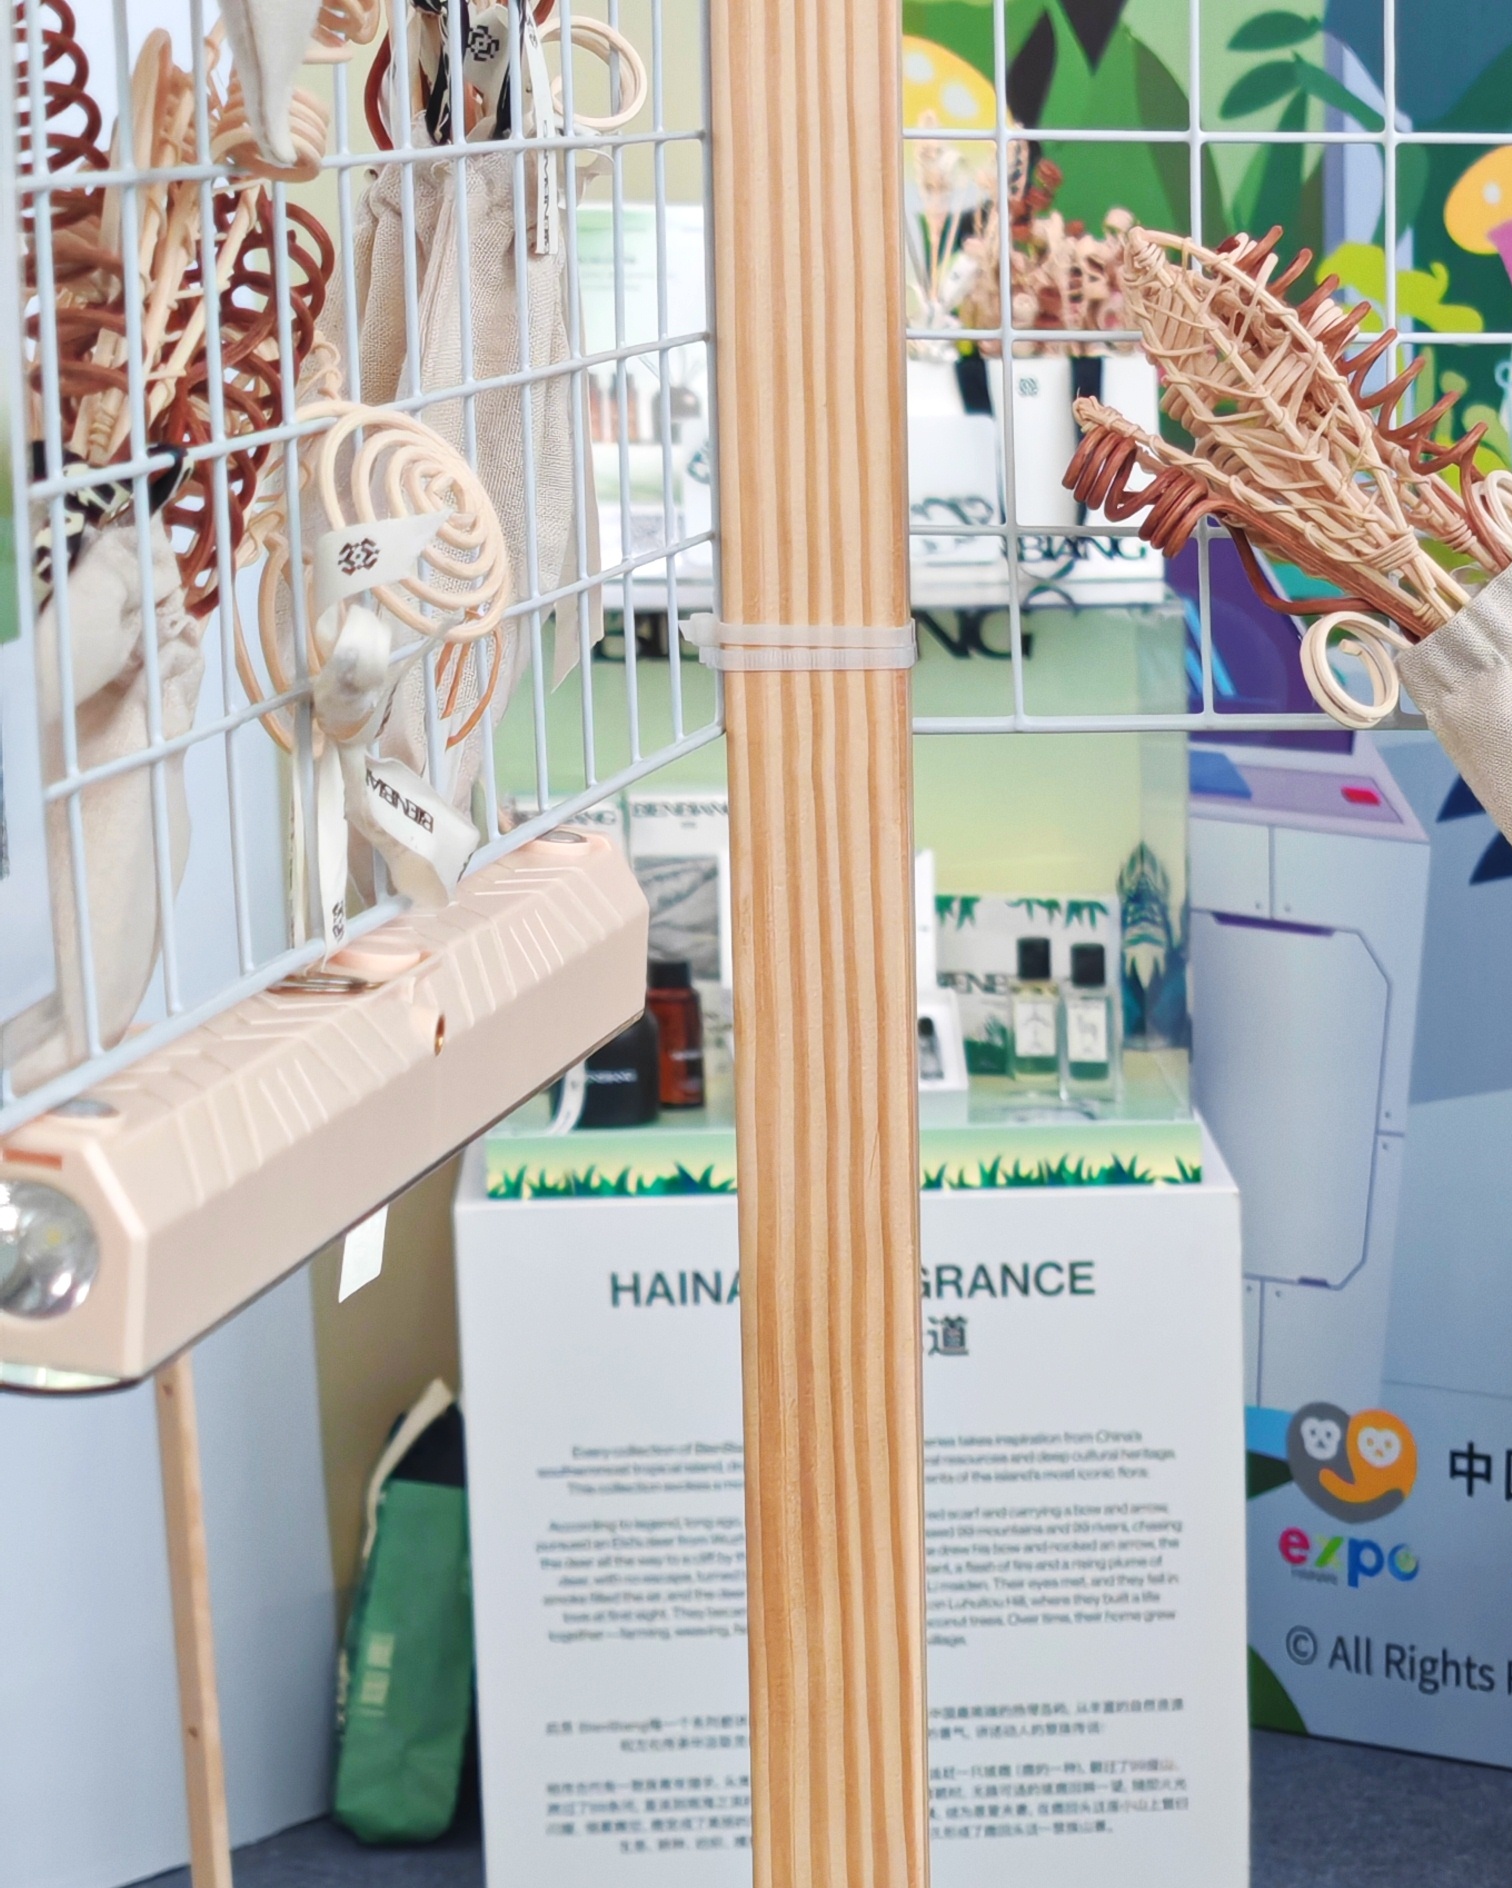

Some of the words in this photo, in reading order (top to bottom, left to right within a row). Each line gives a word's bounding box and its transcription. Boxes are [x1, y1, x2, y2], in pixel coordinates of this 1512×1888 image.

[912, 607, 1033, 660] NG
[924, 1315, 969, 1357] 道
[1328, 1635, 1373, 1676] All
[1384, 1643, 1495, 1694] Rights
